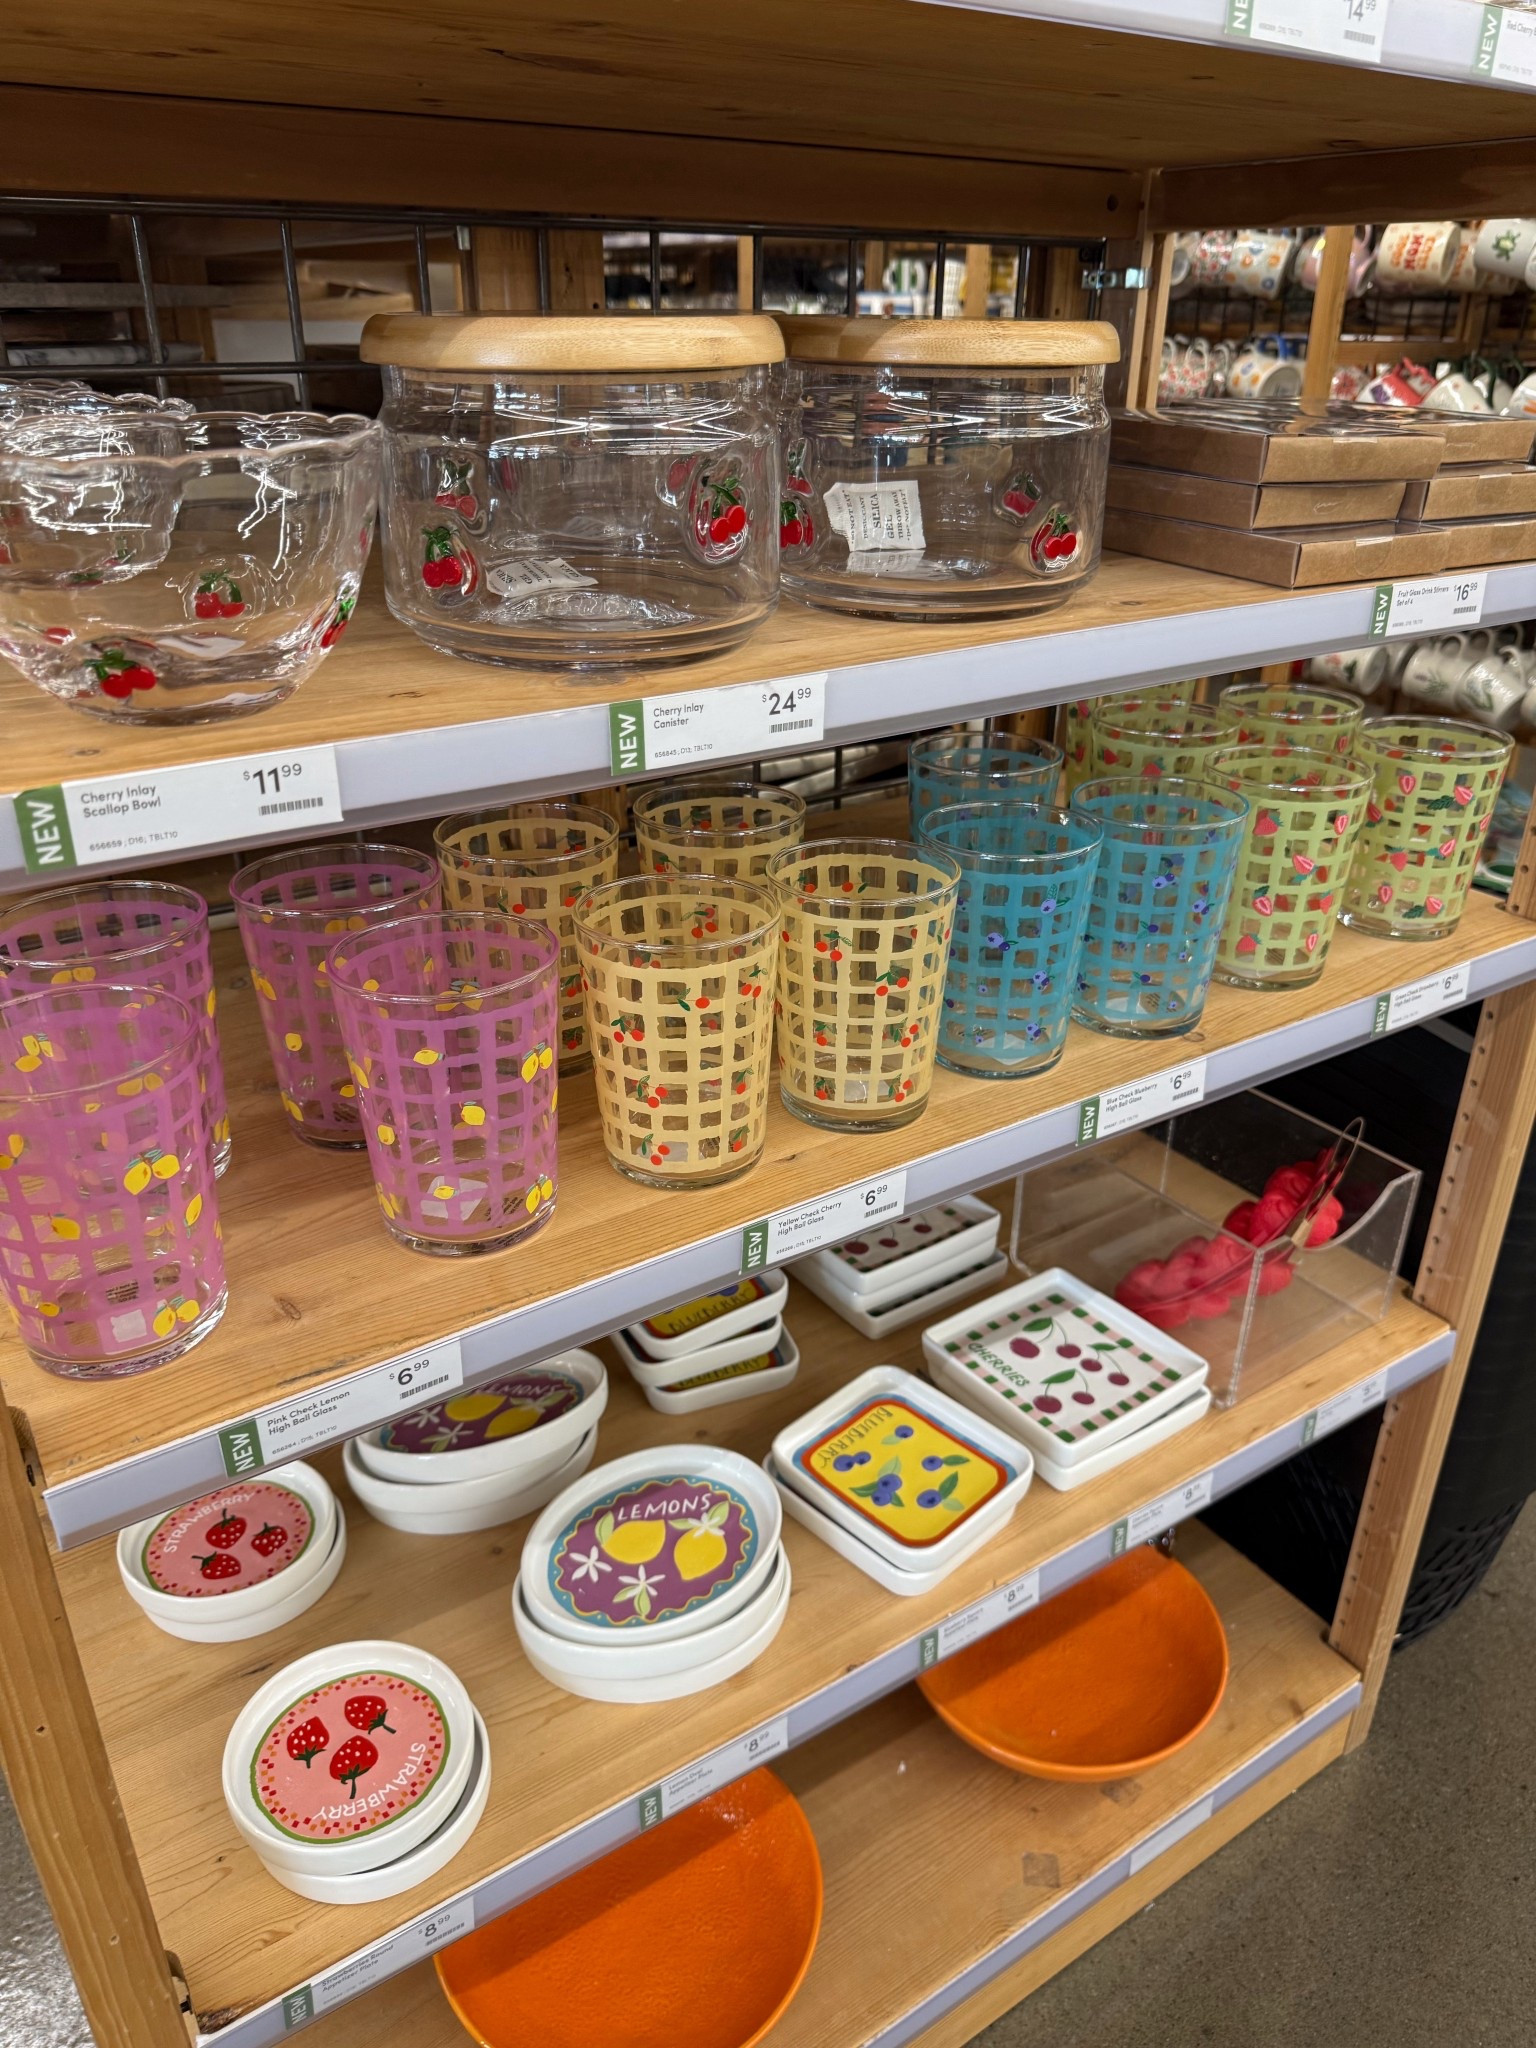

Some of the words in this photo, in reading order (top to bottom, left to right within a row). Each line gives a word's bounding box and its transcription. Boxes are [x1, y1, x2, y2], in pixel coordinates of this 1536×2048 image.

[1232, 0, 1249, 29] NE
[1478, 13, 1498, 70] NEW
[870, 494, 881, 529] SILICA
[886, 514, 895, 539] GEL
[1374, 593, 1389, 634] NEW
[653, 707, 682, 717] Cherry
[684, 703, 704, 713] Inlay
[653, 717, 689, 729] Canister
[618, 713, 638, 769] NEW
[80, 790, 124, 804] Cherry
[126, 784, 156, 798] Inlay
[83, 803, 129, 818] Scallop
[132, 796, 161, 810] Bowl
[26, 800, 64, 865] NEW
[1375, 1001, 1387, 1033] NEW
[1119, 1091, 1133, 1100] Check
[1134, 1084, 1157, 1095] Blueberry
[1082, 1106, 1095, 1140] NEW
[1105, 1104, 1118, 1112] High
[777, 1226, 793, 1236] High
[793, 1220, 807, 1230] Ball
[807, 1216, 824, 1225] Glass
[778, 1217, 800, 1228] Yellow
[800, 1209, 820, 1220] Check
[820, 1202, 842, 1213] Cherry
[748, 1232, 762, 1268] NEW
[968, 1342, 1030, 1388] CHERRIES
[267, 1414, 288, 1427] Pink
[289, 1403, 318, 1418] Check
[320, 1391, 350, 1406] Lemon
[268, 1422, 291, 1435] High
[292, 1413, 311, 1426] Ball
[312, 1405, 338, 1418] Glass
[229, 1432, 256, 1473] NEW
[817, 1406, 894, 1469] BLUEBERRY
[617, 1492, 712, 1521] LEMONS
[163, 1491, 256, 1554] STRAWBERRY
[311, 1742, 427, 1821] STRAWBERRY
[644, 1797, 657, 1826] NEW
[360, 1960, 378, 1971] Plate
[371, 1944, 393, 1960] Round
[290, 1993, 307, 2025] NEW
